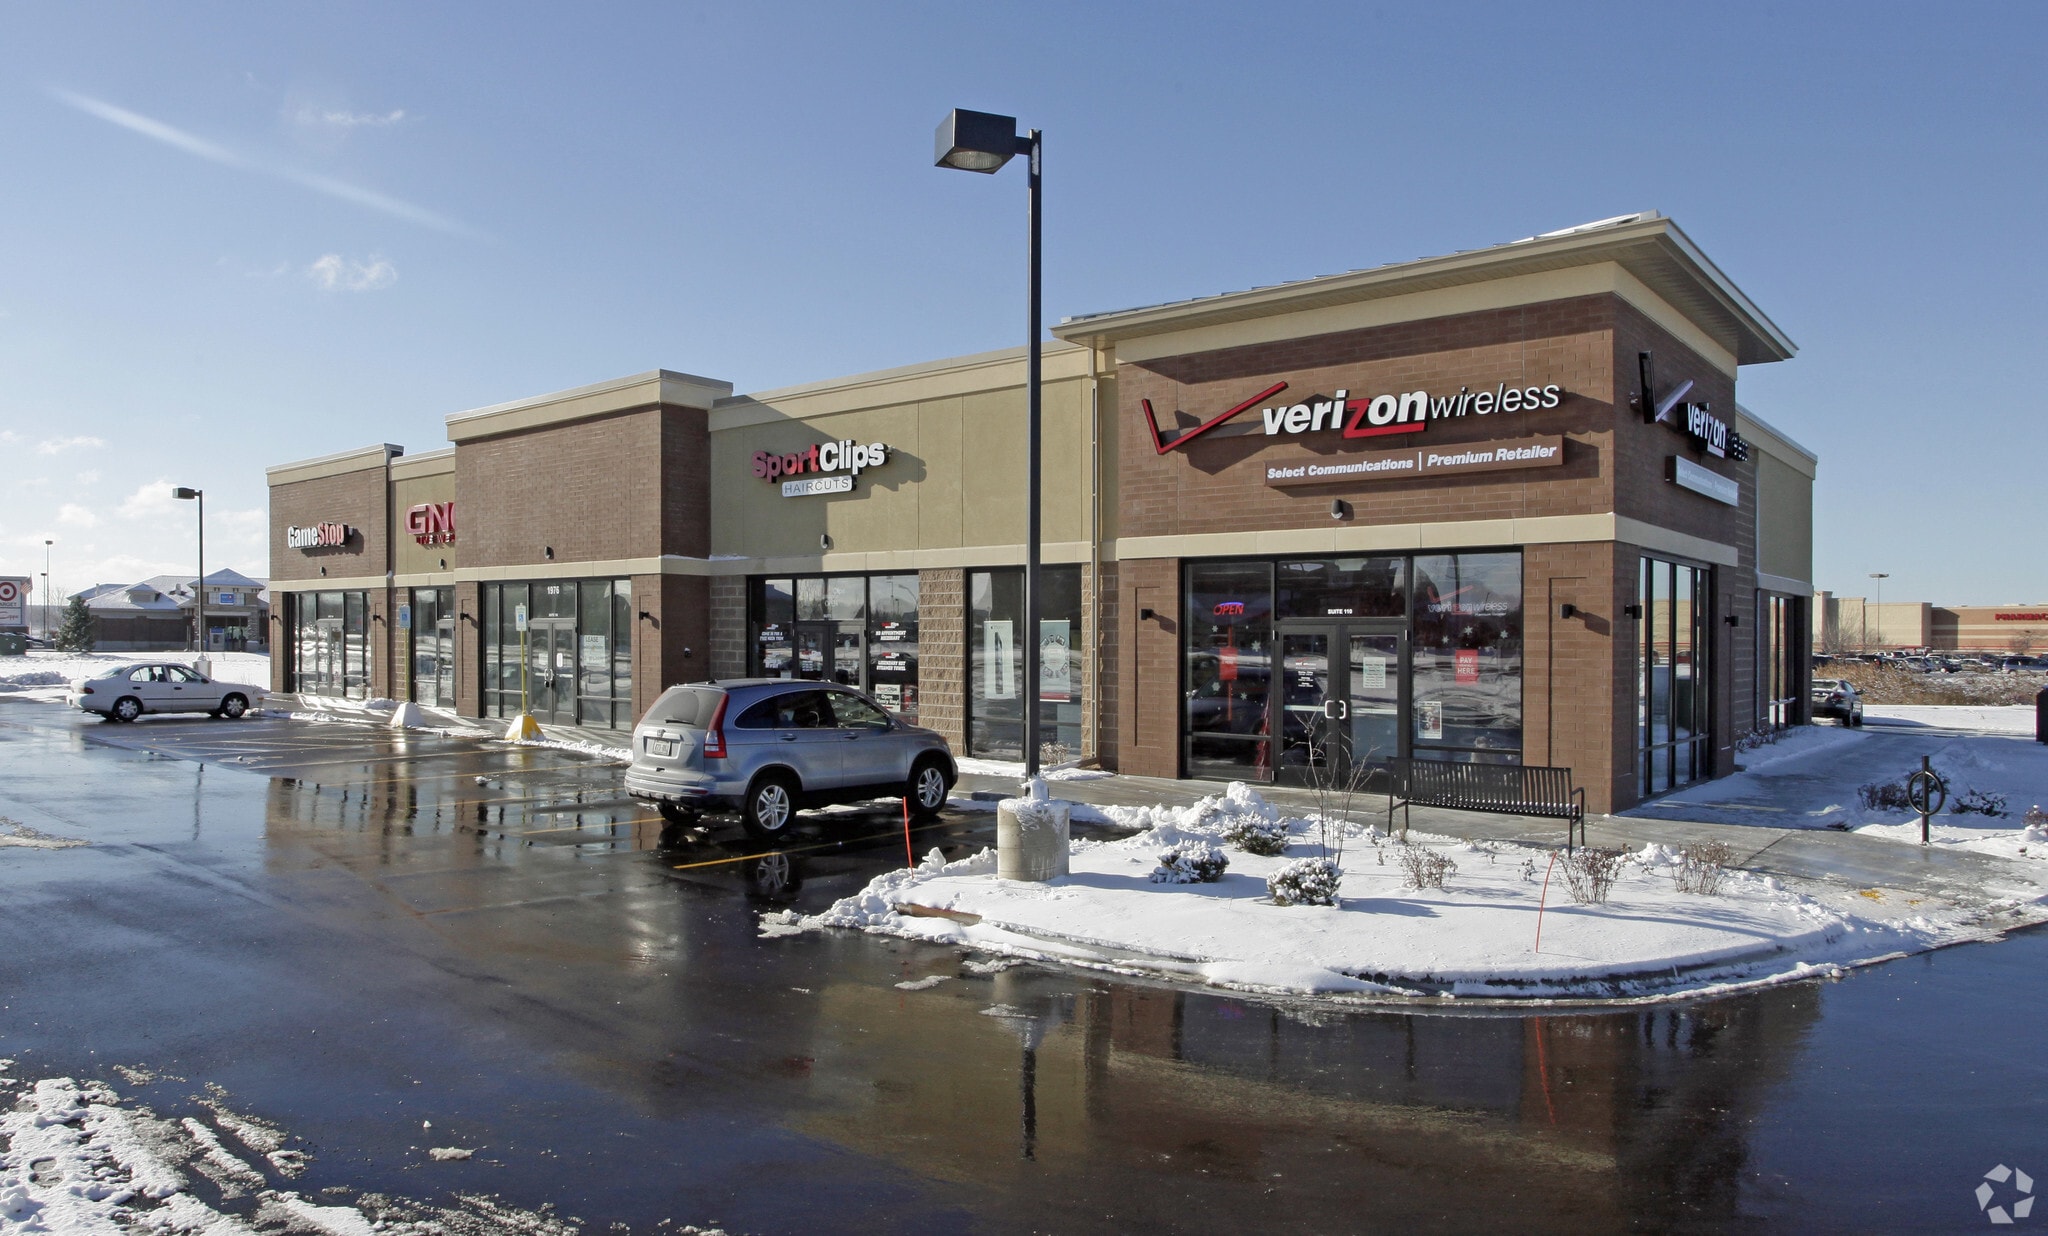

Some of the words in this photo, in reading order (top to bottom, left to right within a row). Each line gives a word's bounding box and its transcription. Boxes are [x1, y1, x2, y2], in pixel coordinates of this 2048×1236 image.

[1262, 388, 1428, 439] verizon
[1430, 383, 1560, 419] wireless
[1687, 402, 1726, 458] verizon
[1267, 466, 1305, 479] Select
[1308, 458, 1414, 476] Communications
[1427, 451, 1493, 467] Premium
[1495, 445, 1557, 462] Retailer
[784, 478, 849, 494] HAIRCUTS
[404, 502, 456, 535] GN
[288, 521, 346, 549] GameStop
[1213, 603, 1245, 615] OPEN
[1473, 601, 1508, 611] wireless
[1457, 667, 1476, 675] HERE
